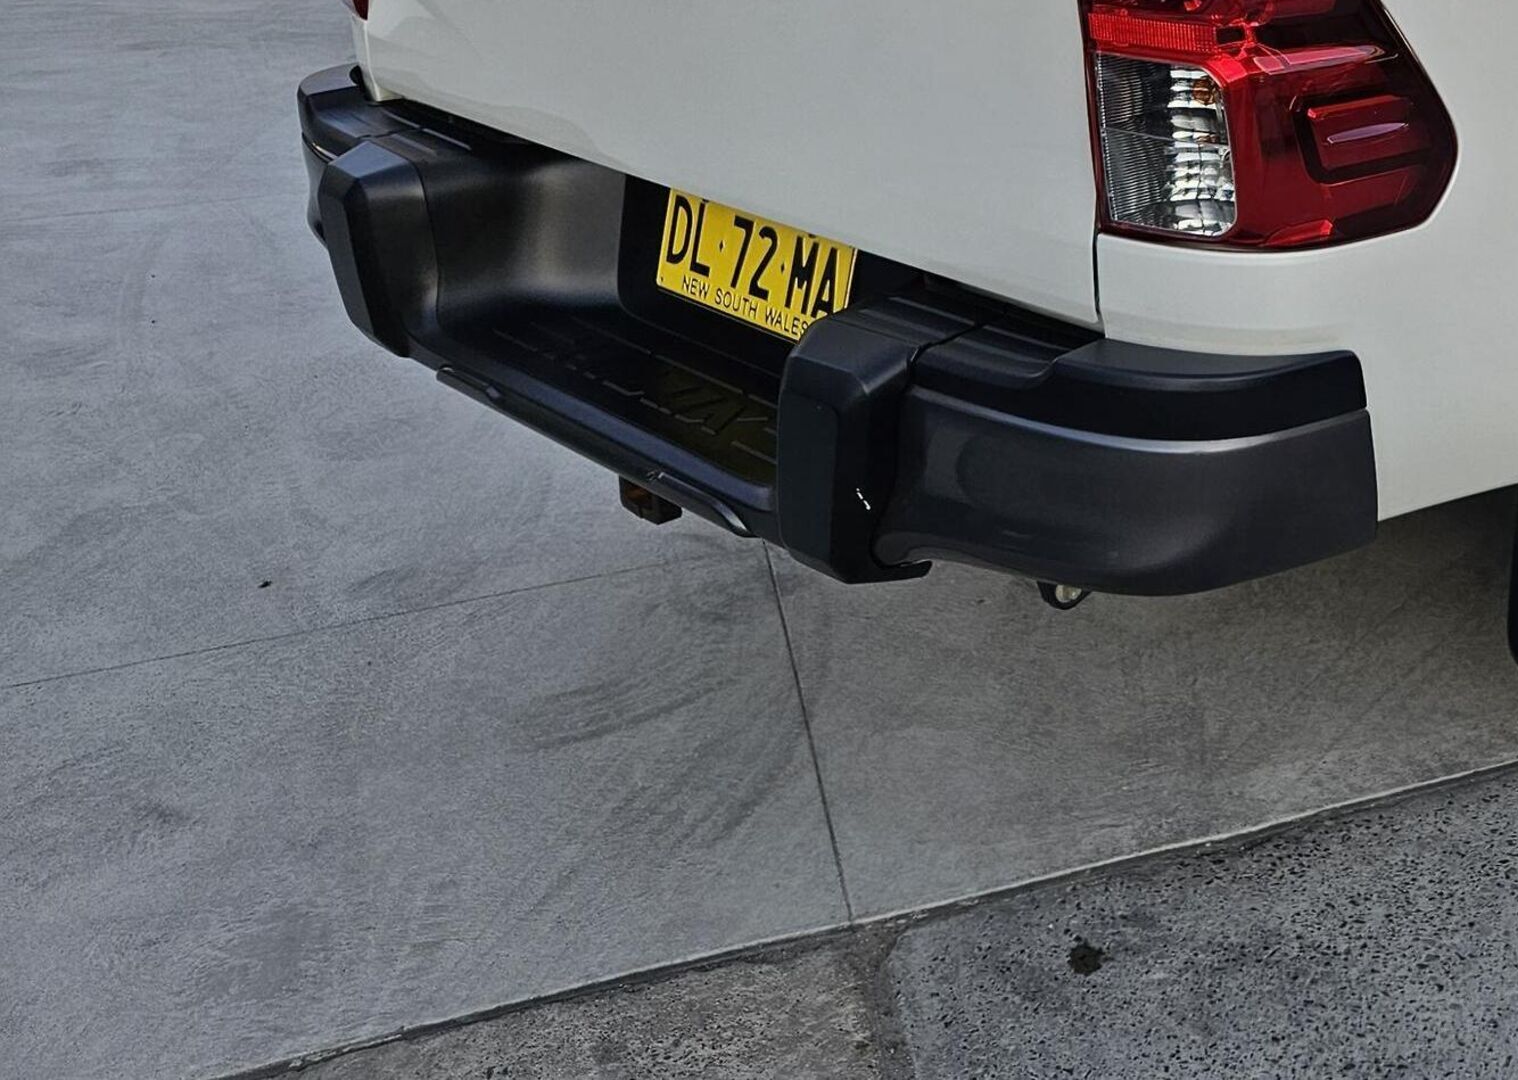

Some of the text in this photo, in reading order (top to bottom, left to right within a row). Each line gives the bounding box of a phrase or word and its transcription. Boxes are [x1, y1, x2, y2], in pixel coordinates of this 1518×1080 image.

[682, 275, 808, 336] NEW SOUTH WALES
